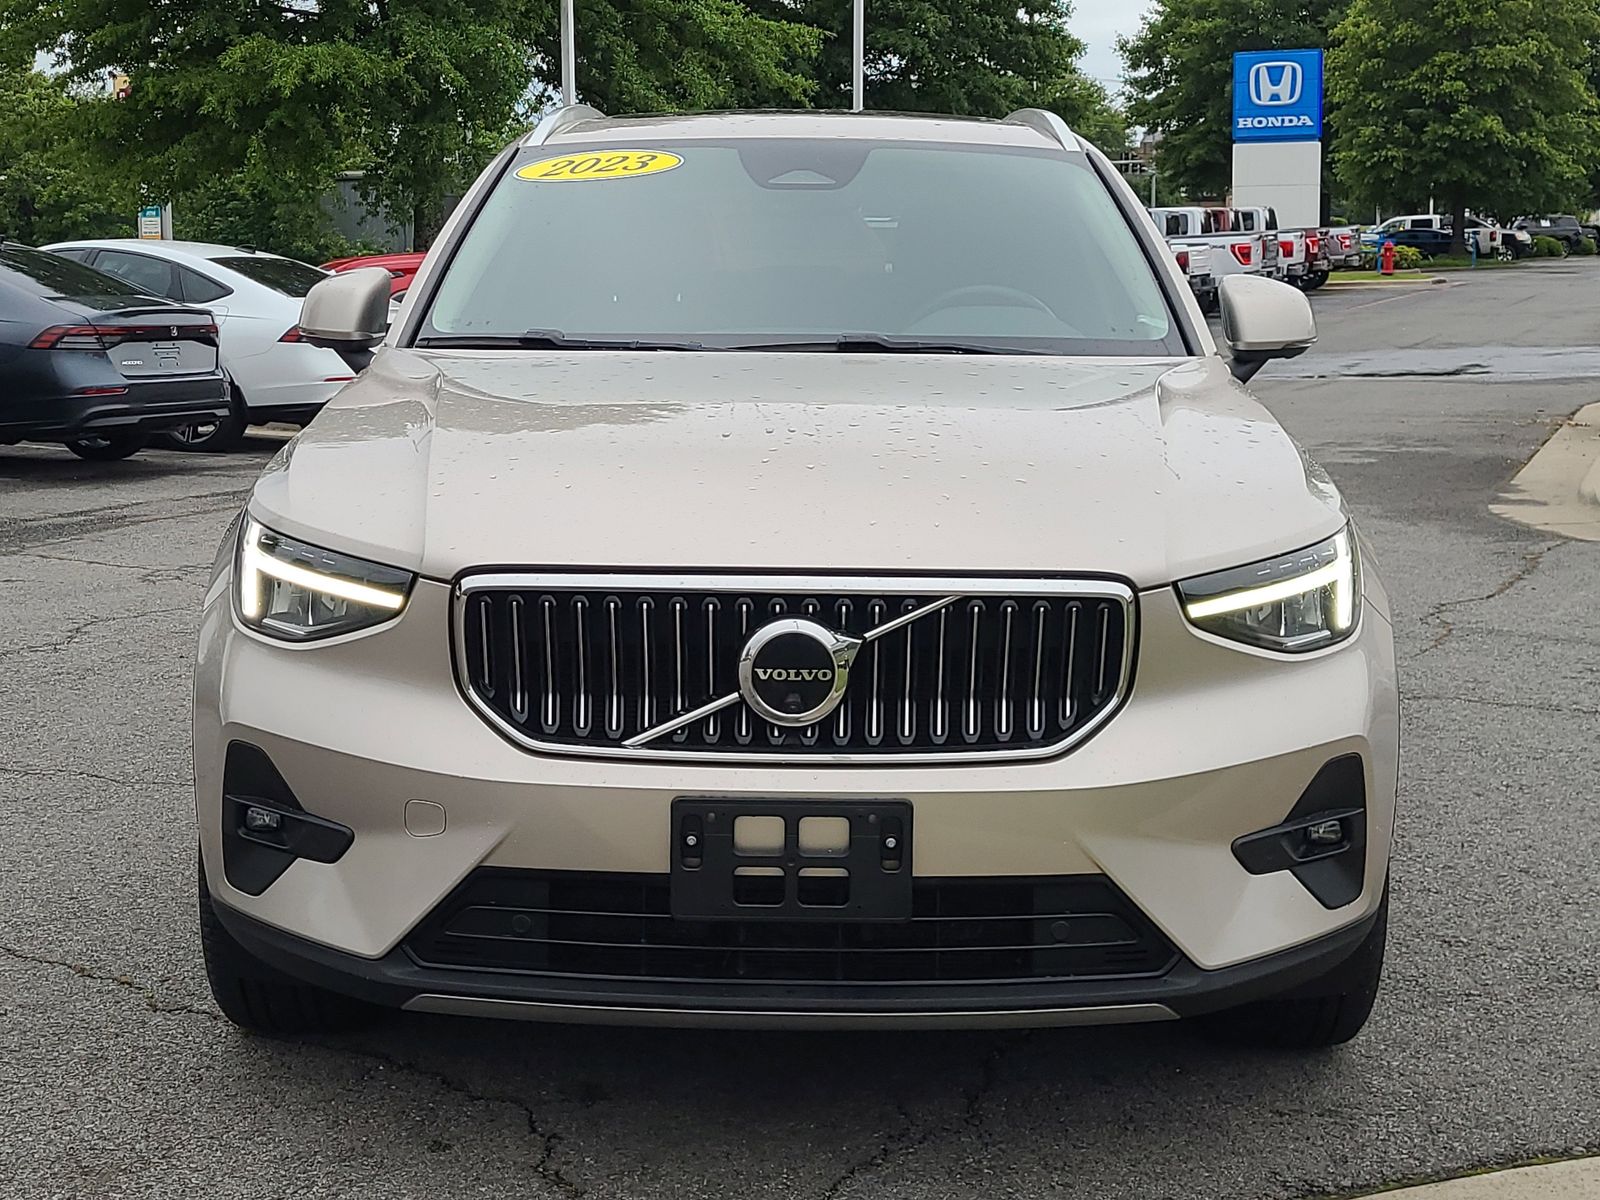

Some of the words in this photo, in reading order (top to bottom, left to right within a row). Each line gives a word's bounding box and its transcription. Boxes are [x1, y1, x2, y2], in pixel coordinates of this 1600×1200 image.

[1237, 115, 1314, 128] HONDA
[538, 154, 658, 177] 2023
[754, 668, 832, 681] VOLVO
